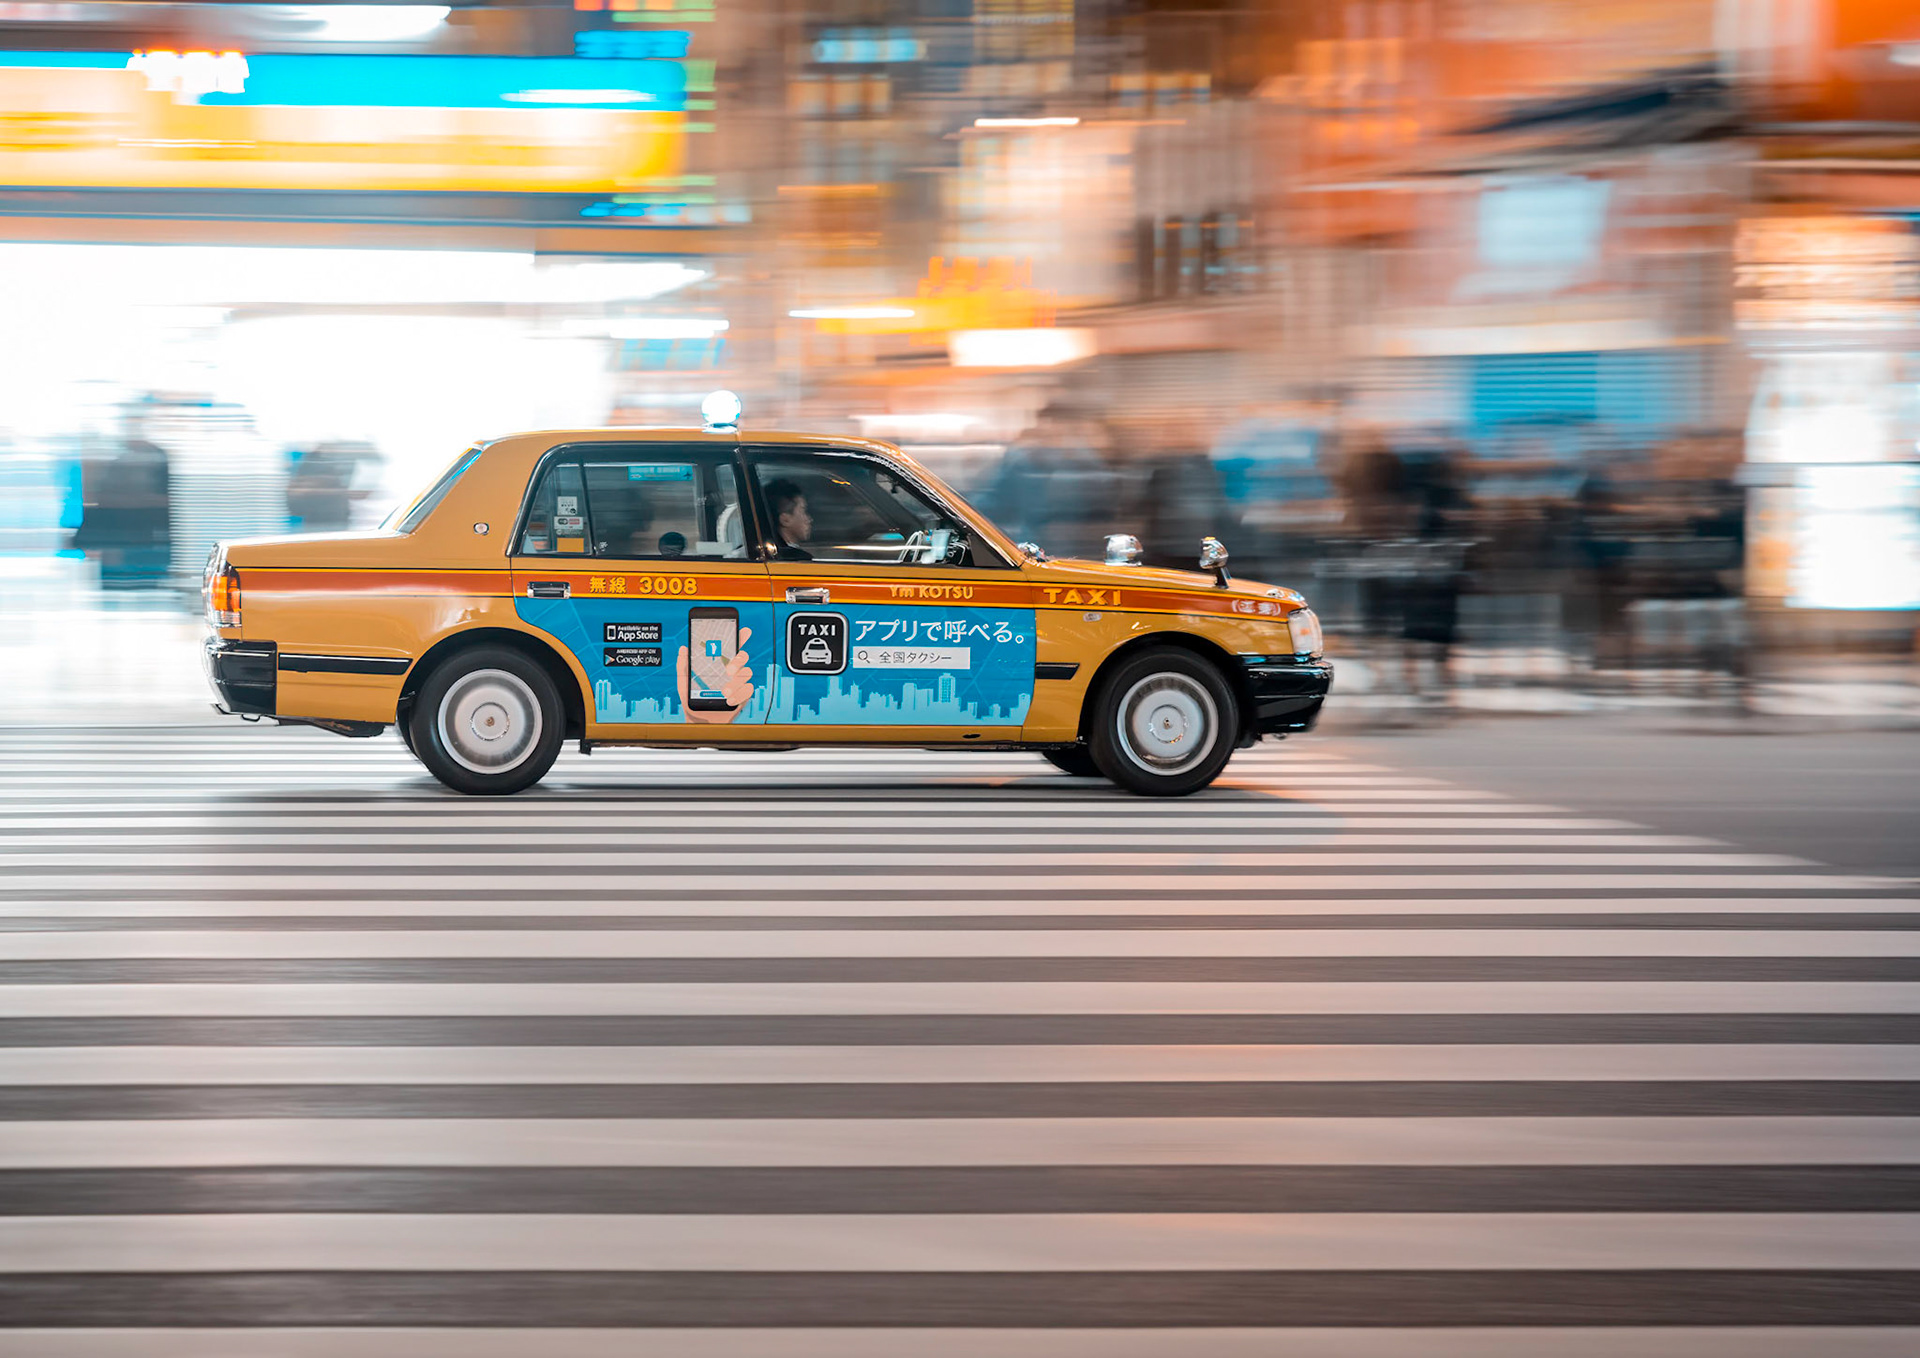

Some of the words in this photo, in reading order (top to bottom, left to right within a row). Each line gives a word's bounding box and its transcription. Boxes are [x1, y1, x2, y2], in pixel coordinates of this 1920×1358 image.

[590, 576, 627, 594] 無線
[639, 576, 698, 595] 3008
[919, 585, 974, 600] KOTSU
[1043, 588, 1122, 606] TAXI
[618, 631, 636, 642] App
[636, 631, 659, 640] Store
[798, 623, 836, 636] TAXI
[855, 619, 1024, 644] アプリで呼べる。
[616, 655, 644, 666] Google
[645, 656, 660, 665] play
[879, 651, 952, 664] 全国タクシー
